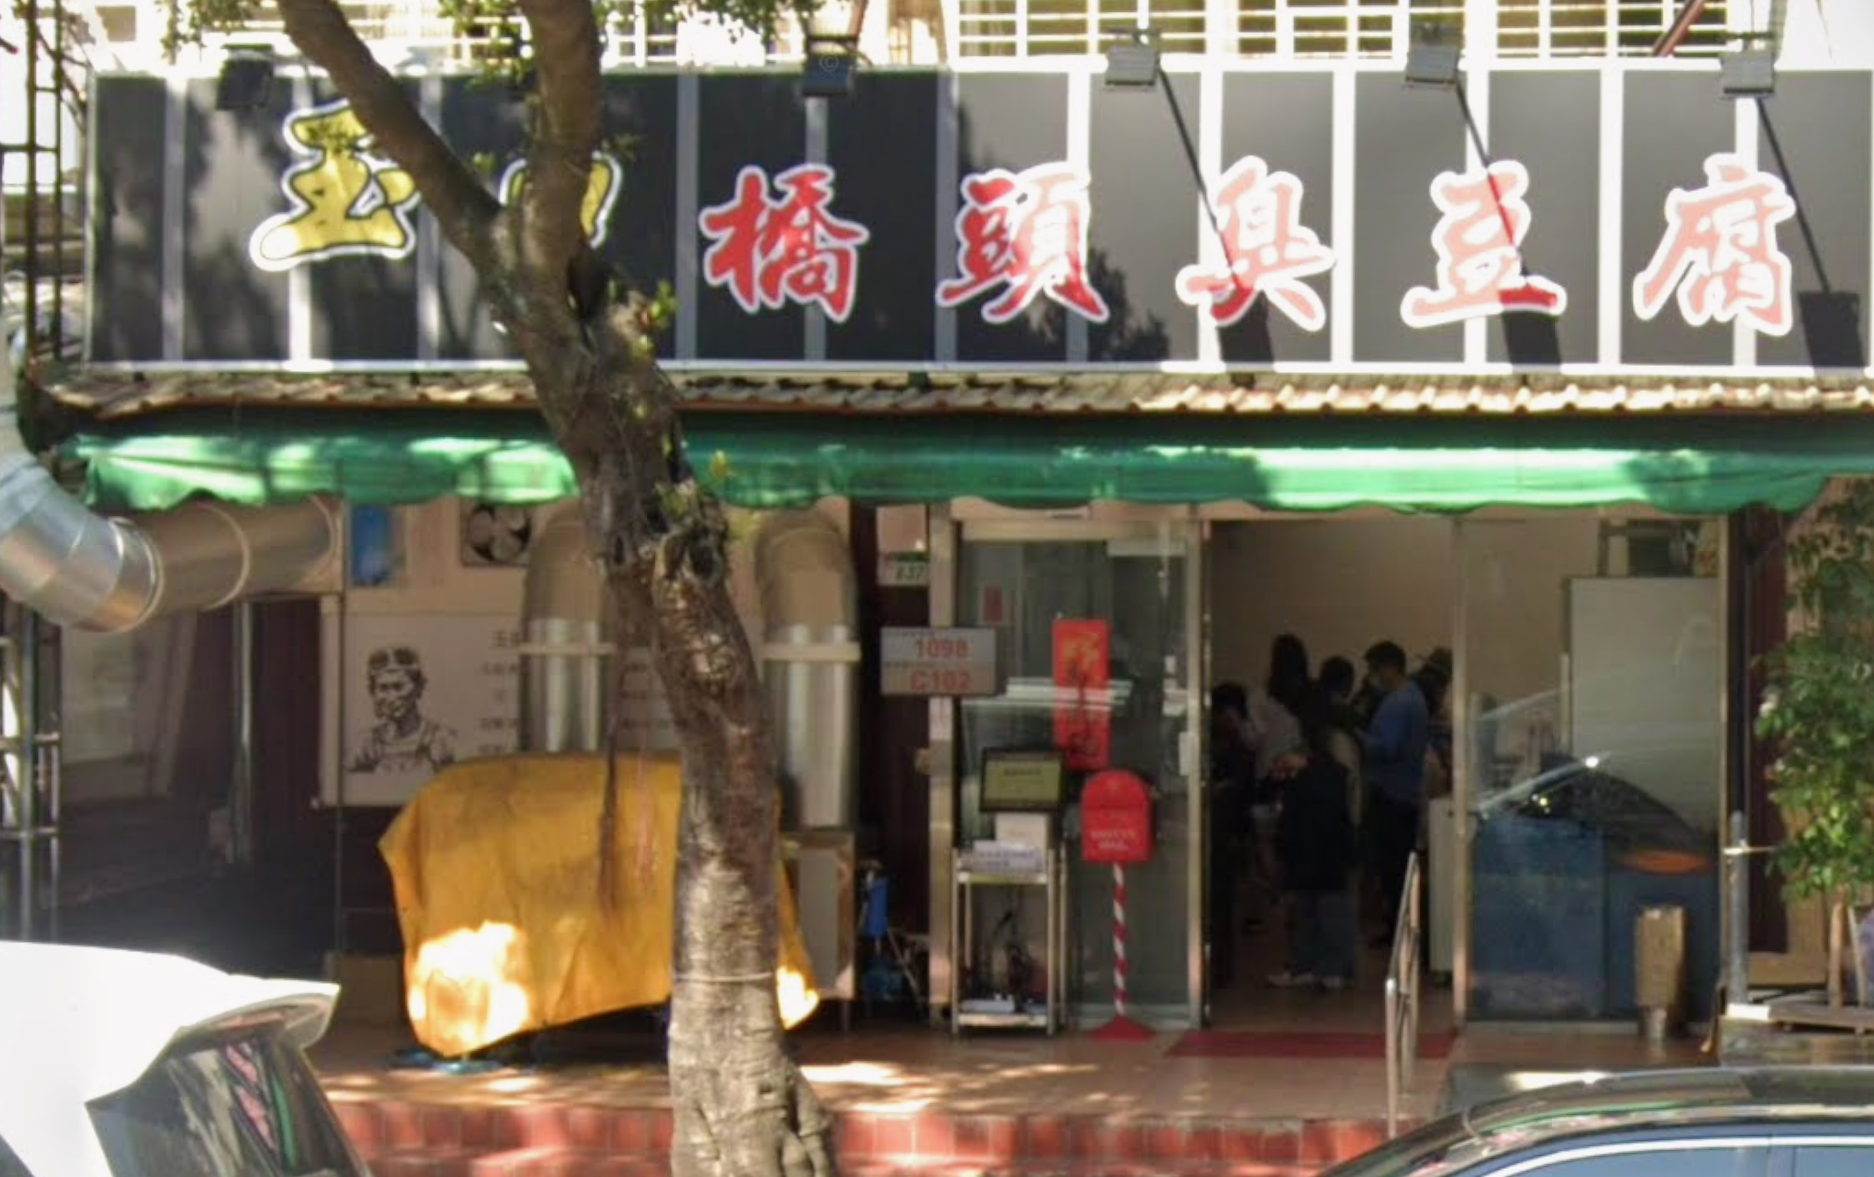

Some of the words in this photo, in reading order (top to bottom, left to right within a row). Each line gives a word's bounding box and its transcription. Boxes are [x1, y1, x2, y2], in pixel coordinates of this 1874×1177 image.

[250, 100, 1797, 337] 玉橋頭臭豆腐
[910, 670, 971, 691] C102
